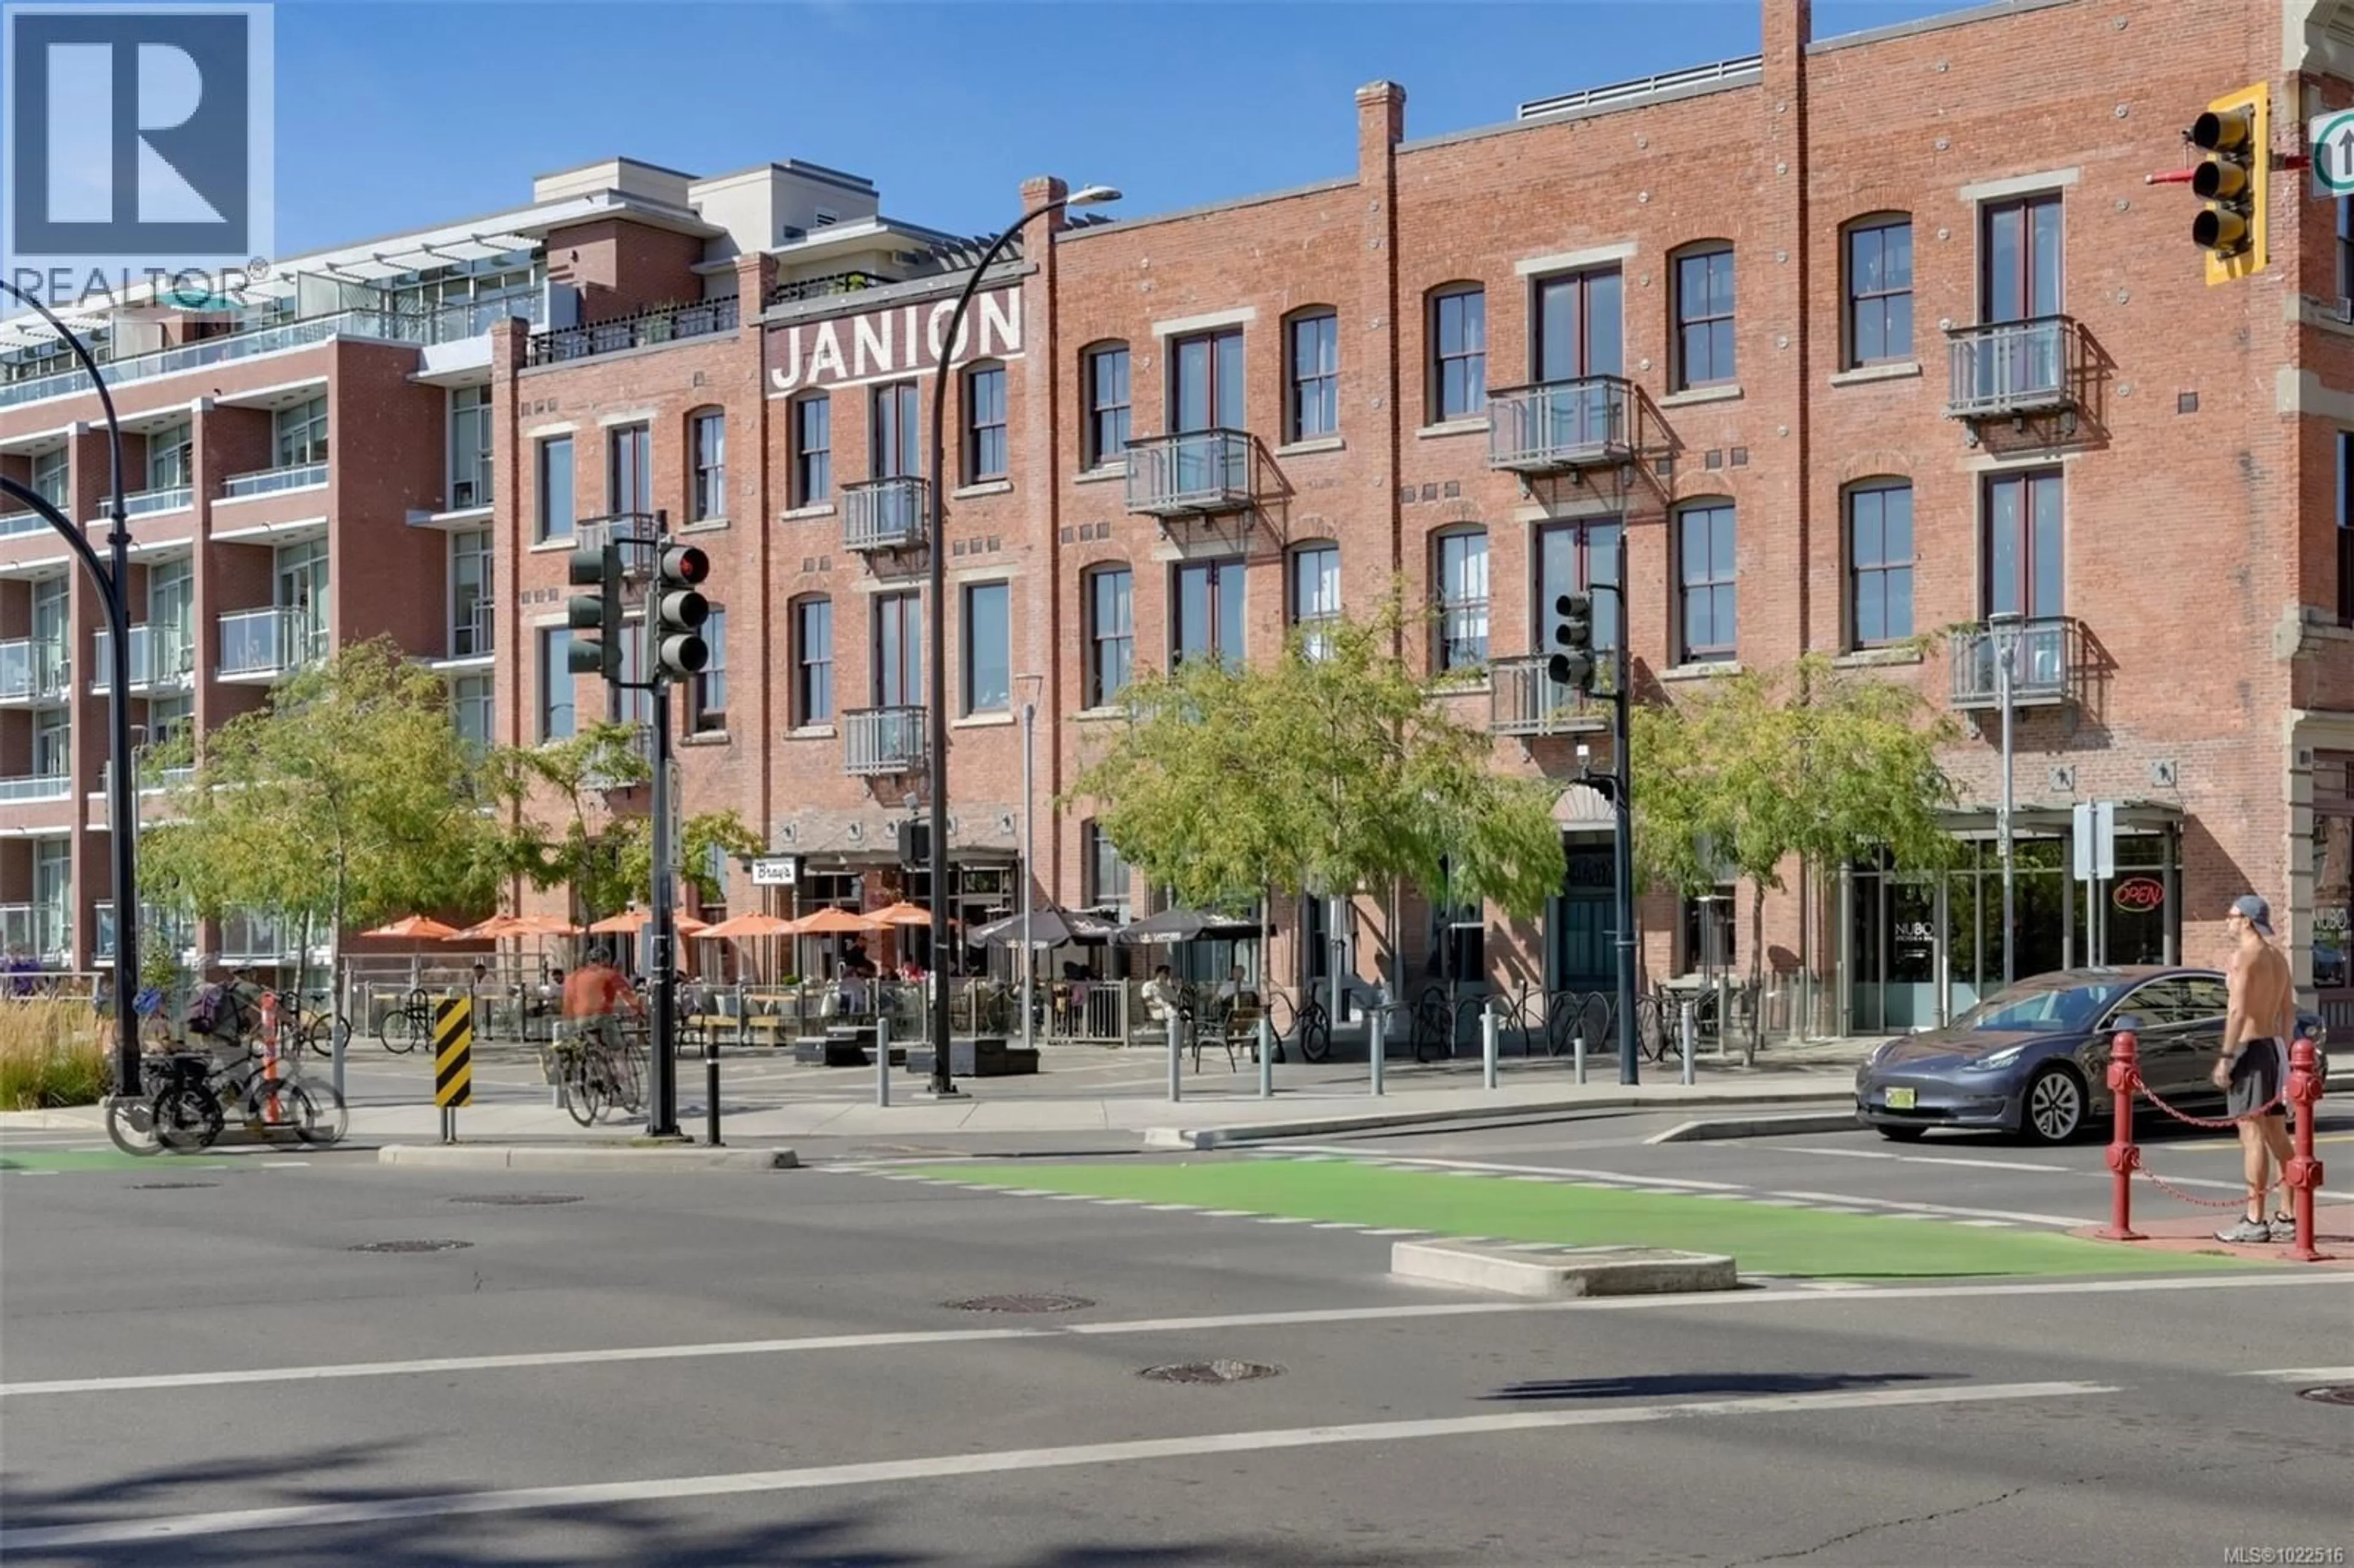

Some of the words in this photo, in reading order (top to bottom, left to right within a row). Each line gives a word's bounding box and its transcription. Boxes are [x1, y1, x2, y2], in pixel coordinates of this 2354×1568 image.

[772, 286, 1021, 389] JANION
[2116, 885, 2160, 904] OPEN
[1895, 922, 1933, 935] NUBO
